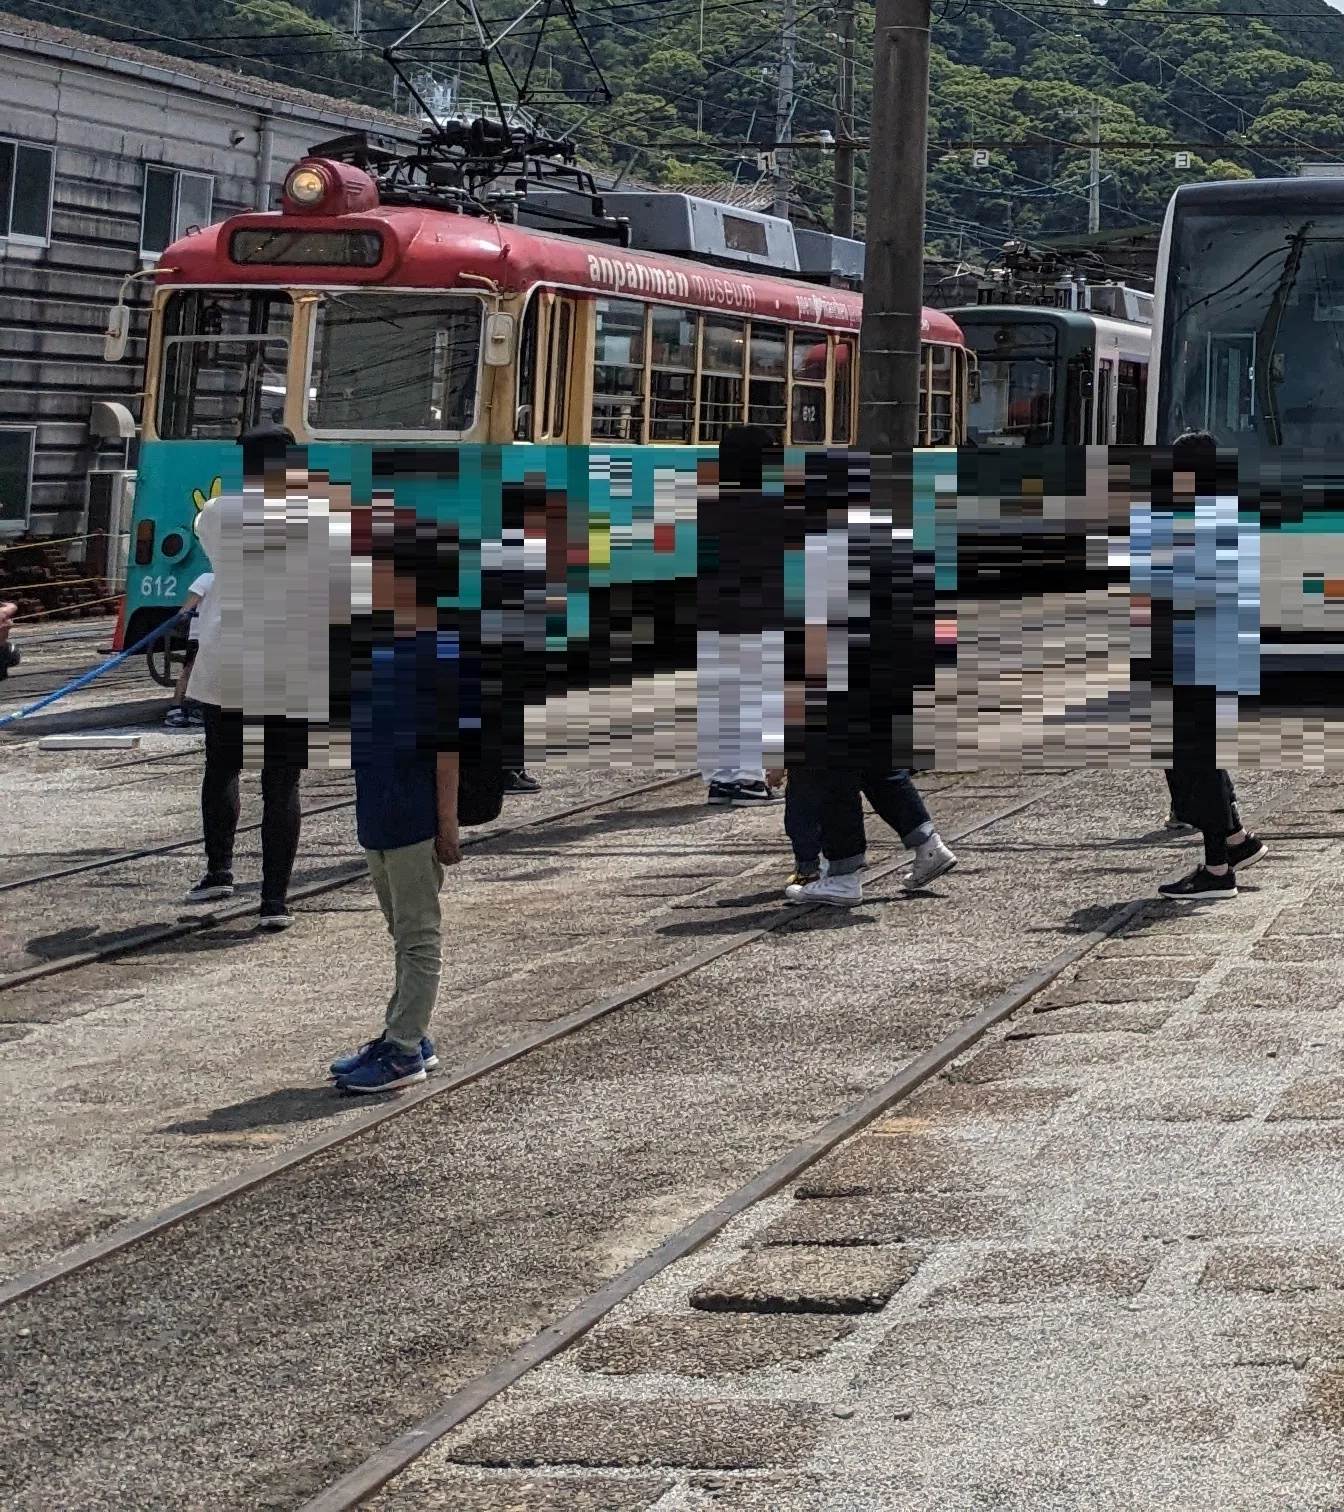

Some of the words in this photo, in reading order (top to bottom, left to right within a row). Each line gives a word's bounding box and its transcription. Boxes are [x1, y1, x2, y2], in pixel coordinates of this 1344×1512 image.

[976, 151, 987, 165] 2
[1178, 153, 1188, 167] 3
[587, 254, 689, 297] anpanman
[692, 274, 757, 309] museum
[141, 575, 178, 597] 612
